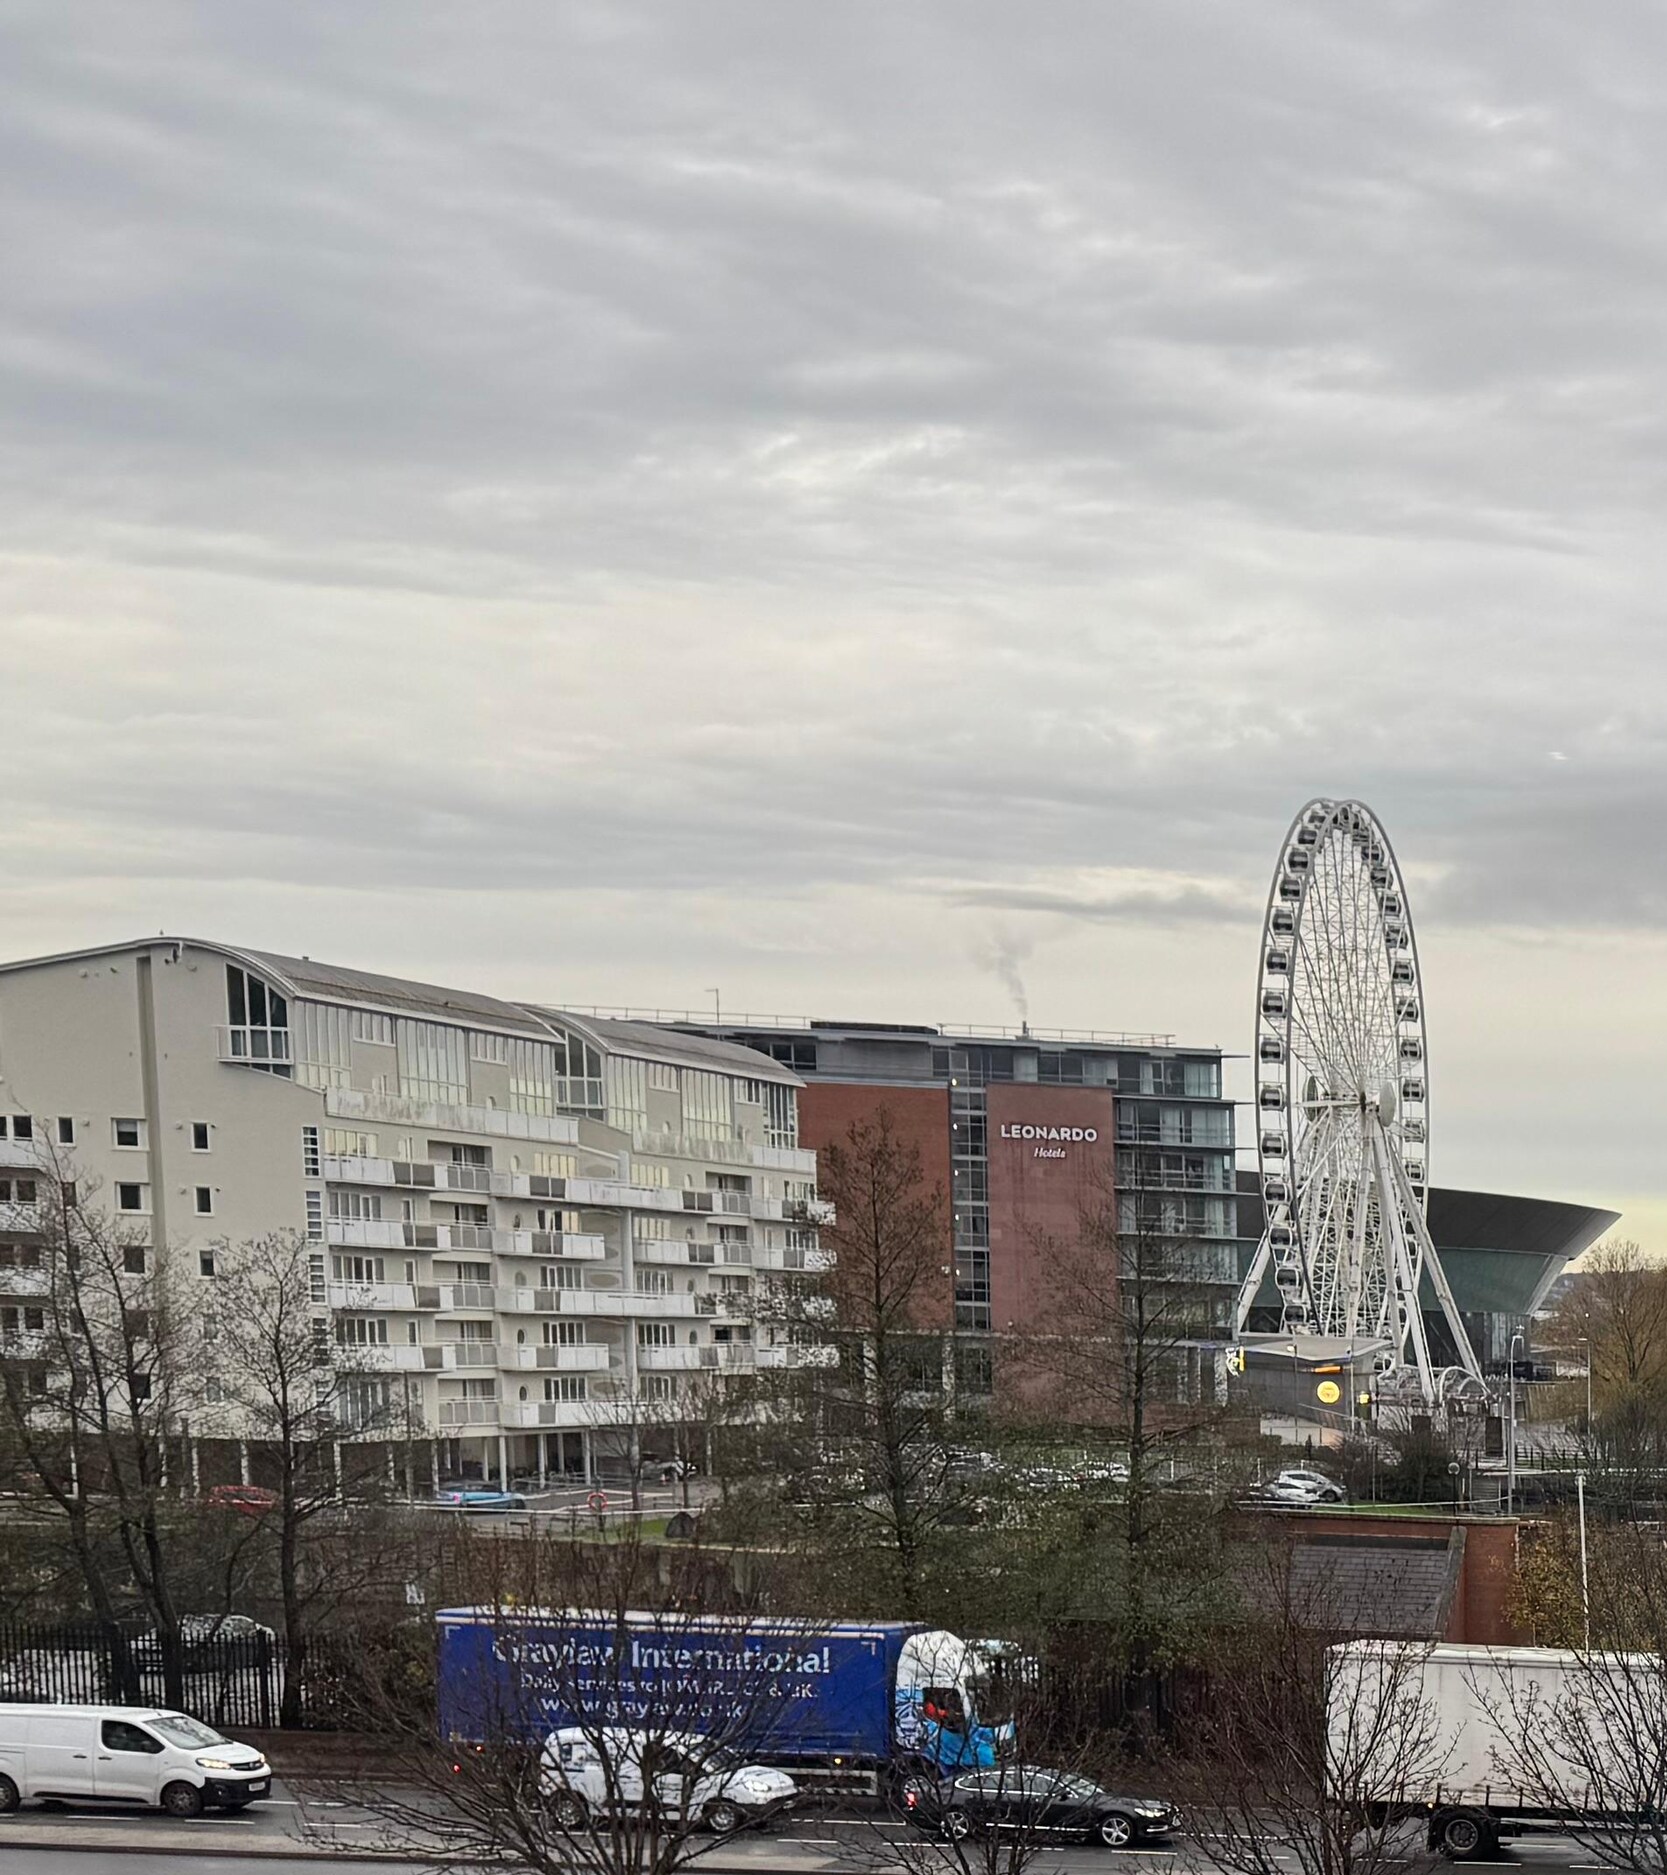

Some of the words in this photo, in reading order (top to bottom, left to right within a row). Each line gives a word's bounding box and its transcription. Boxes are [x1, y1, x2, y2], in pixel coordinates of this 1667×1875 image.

[1001, 1124, 1098, 1142] LEONARDO
[1033, 1147, 1067, 1158] Hotels
[632, 1640, 831, 1674] International
